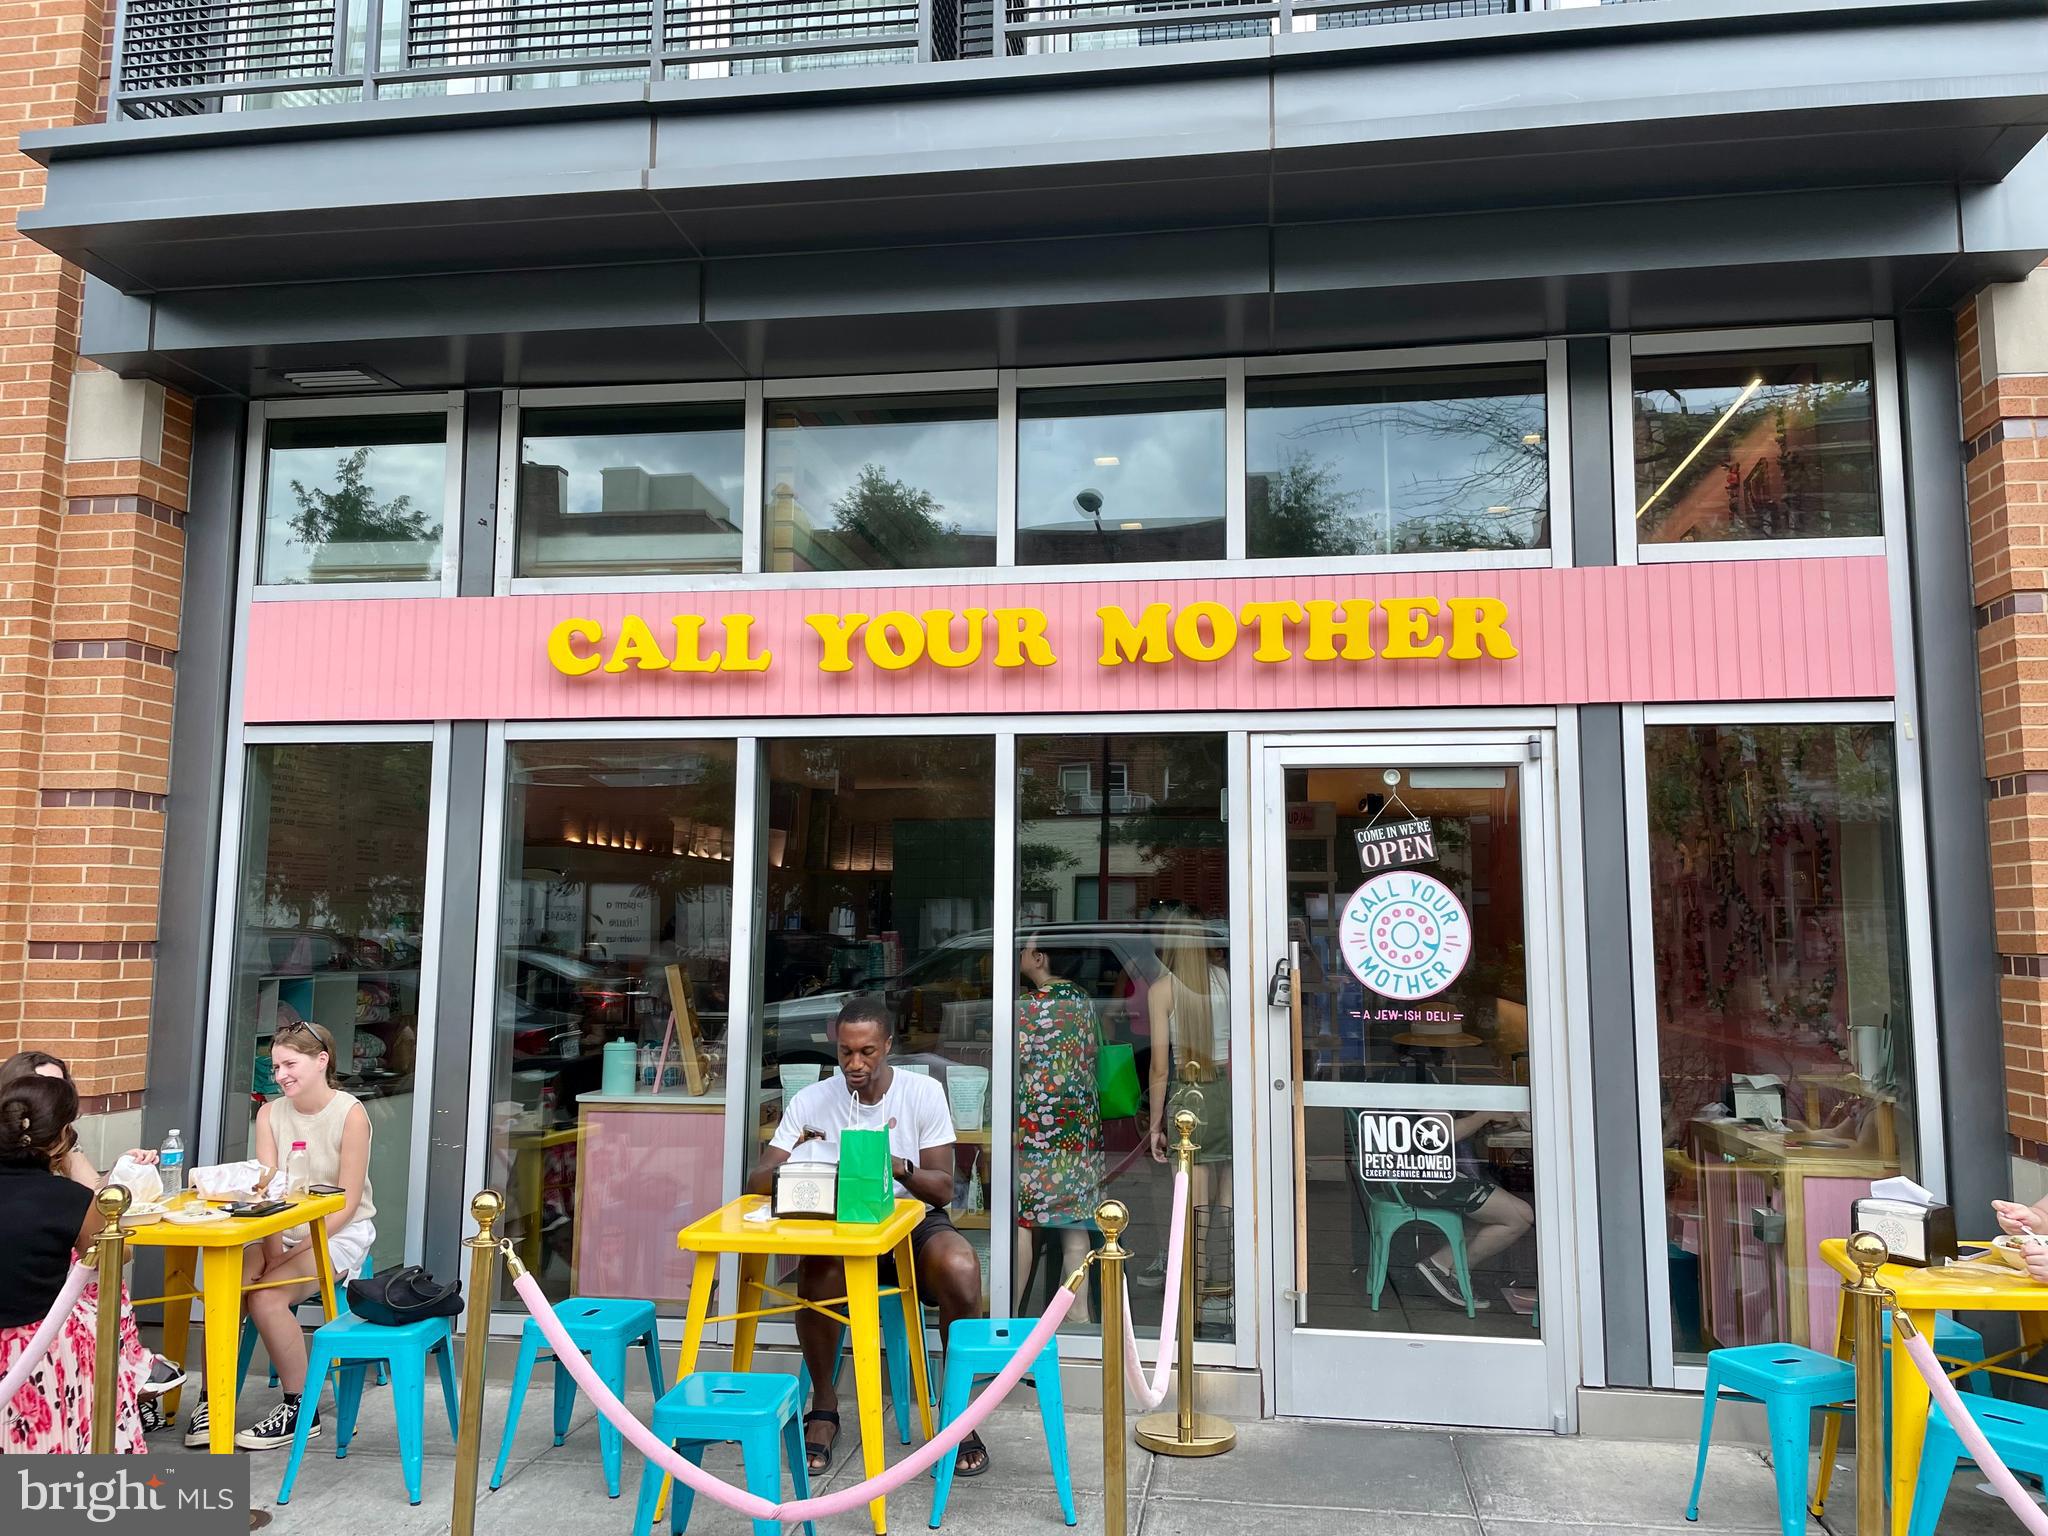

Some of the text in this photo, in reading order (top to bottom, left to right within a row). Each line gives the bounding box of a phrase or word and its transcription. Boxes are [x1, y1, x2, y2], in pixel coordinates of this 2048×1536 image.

[548, 596, 1519, 676] CALL YOUR MOTHER
[1357, 819, 1431, 844] COME IN WE'RE
[1361, 833, 1436, 869] OPEN
[1350, 878, 1460, 926] CALL YOUR
[1357, 956, 1453, 995] MOTHER
[1363, 1009, 1451, 1022] A JEW-ISH DELI
[1363, 1115, 1411, 1154] NO
[1365, 1153, 1452, 1171] PETS ALLOWED
[1365, 1169, 1452, 1179] EXCEPT SERVICE ANIMALS
